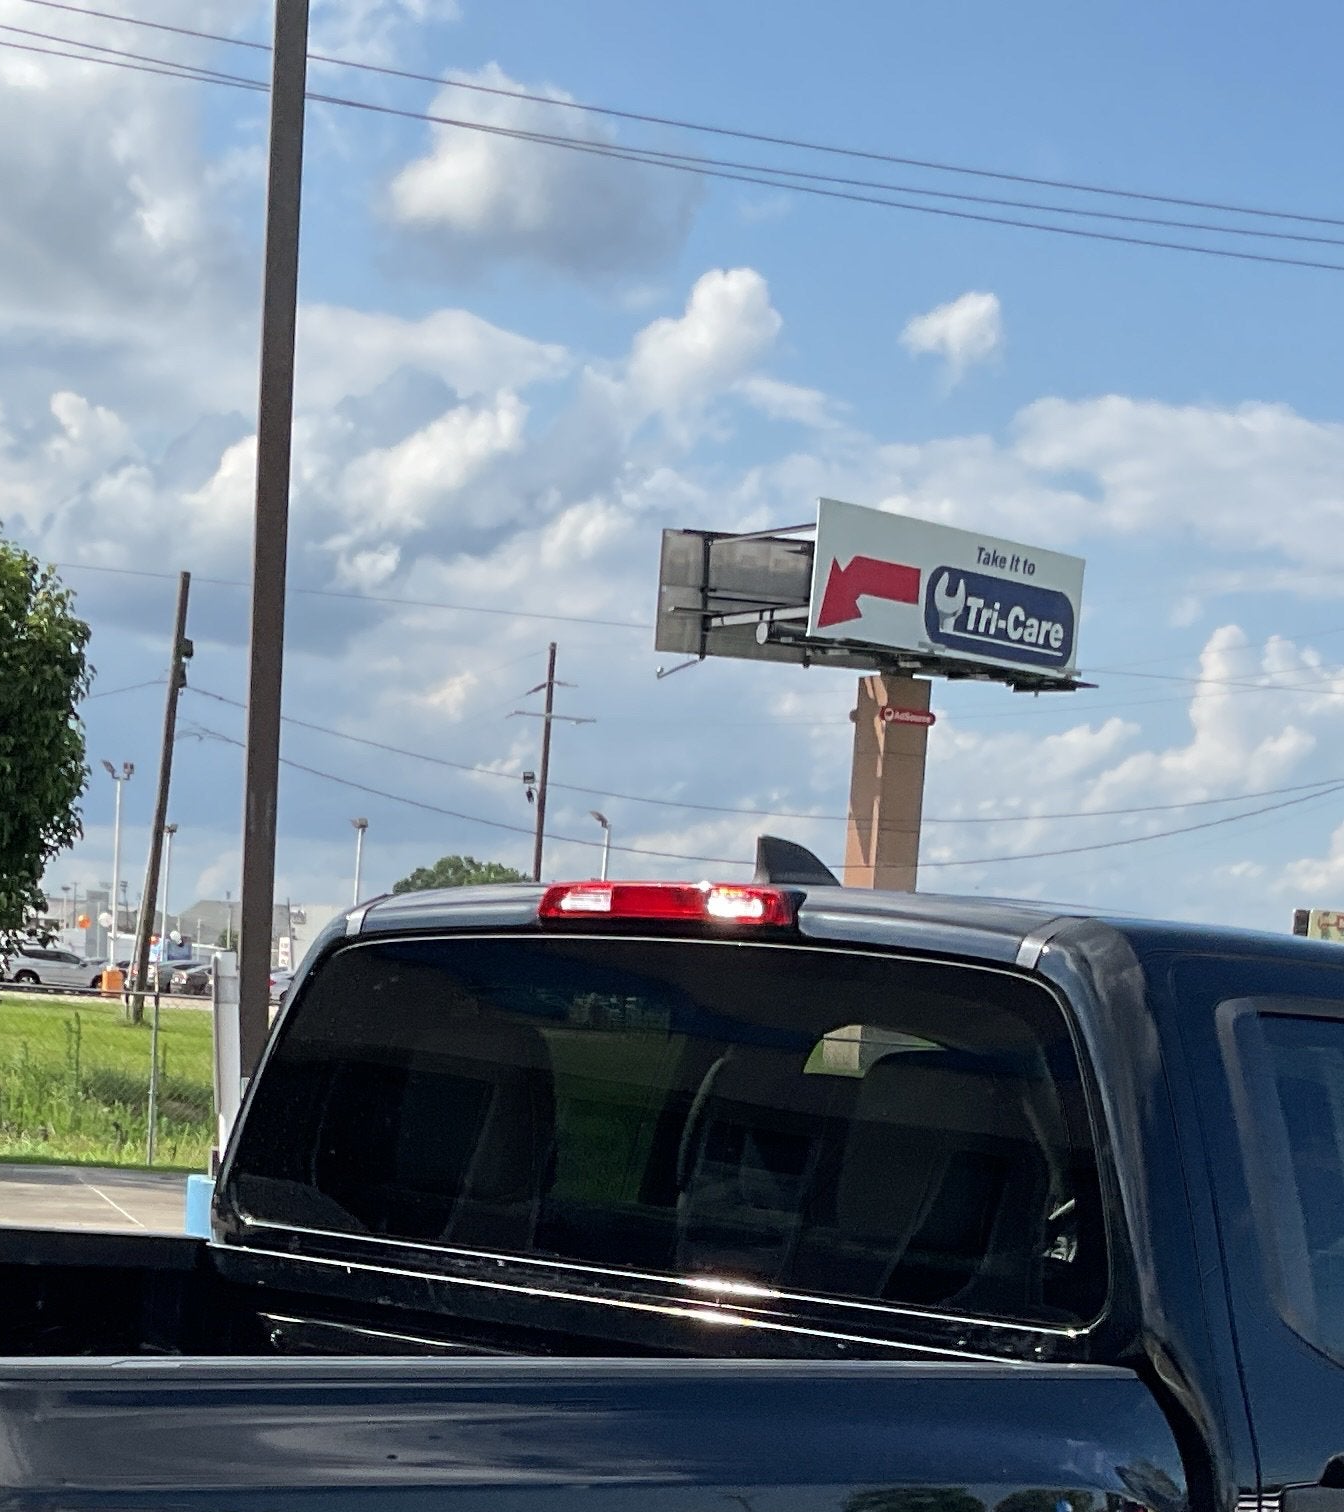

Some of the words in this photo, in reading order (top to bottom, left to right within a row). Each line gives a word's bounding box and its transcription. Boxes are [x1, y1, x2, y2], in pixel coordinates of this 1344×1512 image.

[977, 546, 1006, 570] Take
[1023, 558, 1036, 576] to
[966, 596, 1065, 649] Tri-Care
